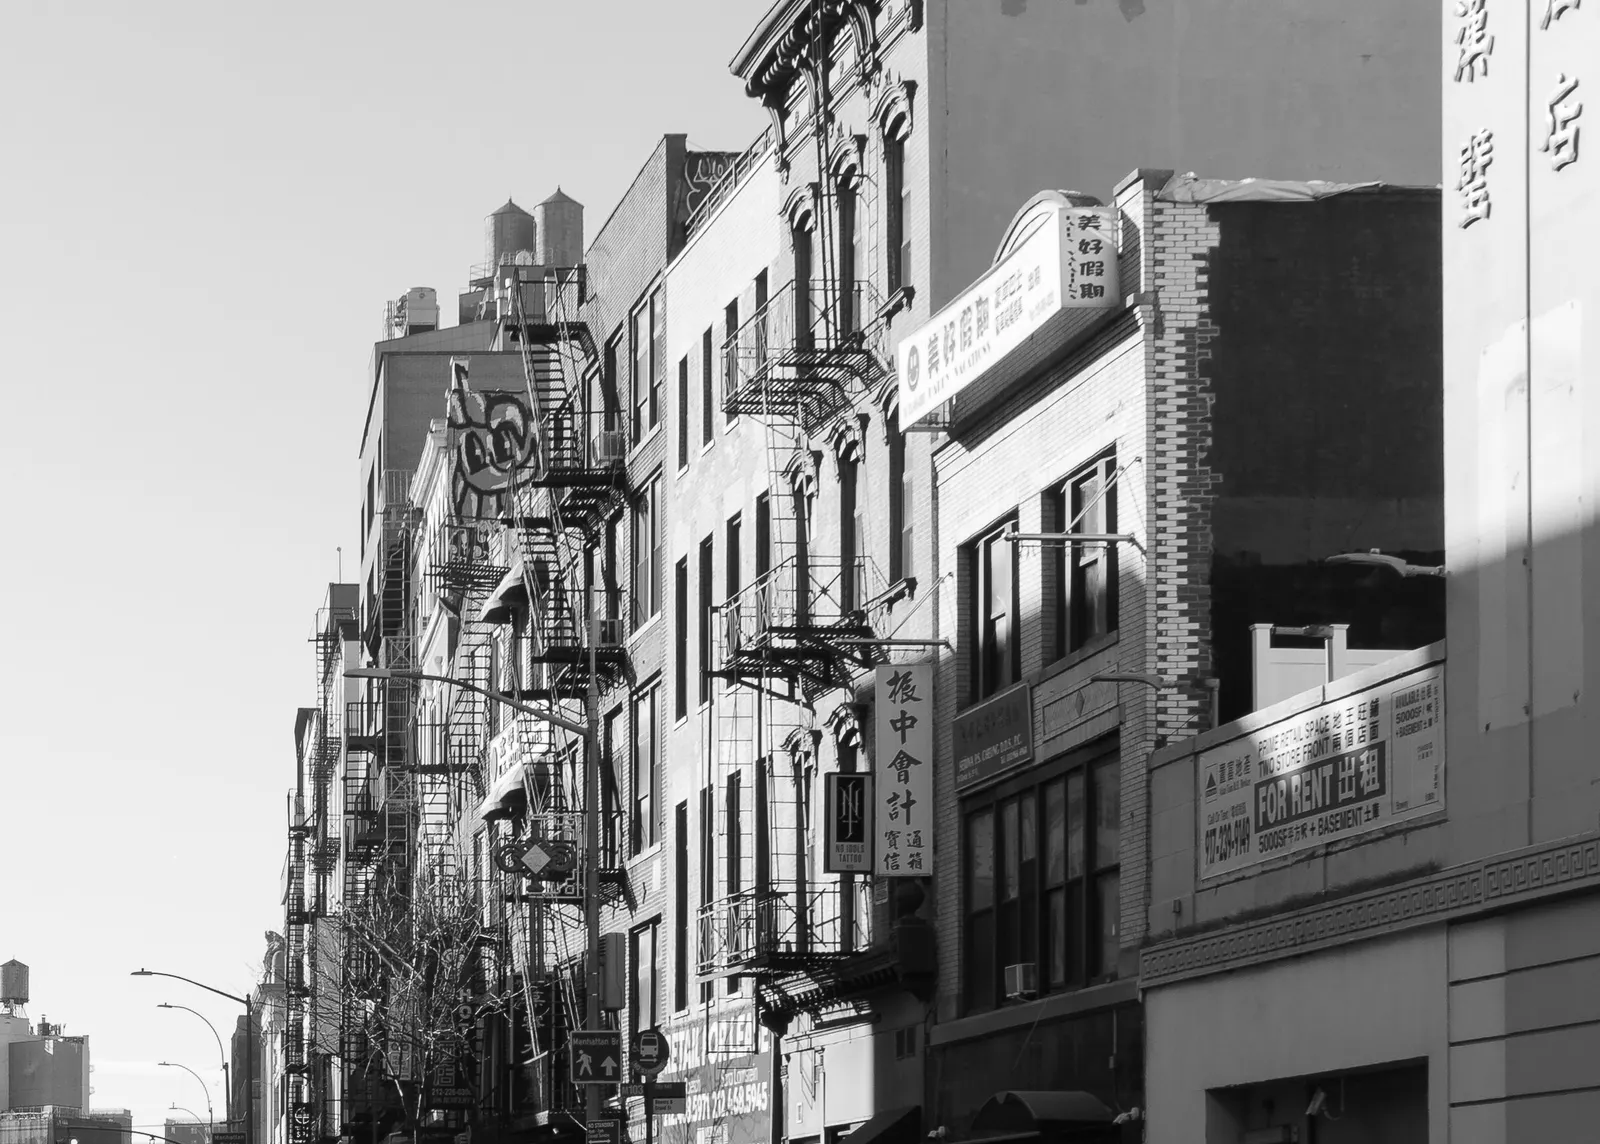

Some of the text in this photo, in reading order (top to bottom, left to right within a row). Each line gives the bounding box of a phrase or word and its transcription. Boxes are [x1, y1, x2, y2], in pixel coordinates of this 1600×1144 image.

[1078, 215, 1104, 299] 美好假期
[928, 296, 989, 379] 美好假期
[1258, 736, 1279, 758] PRIME
[1280, 728, 1304, 749] RETAIL
[1305, 715, 1330, 741] SPACE
[1258, 760, 1275, 778] TWO
[1276, 748, 1300, 772] STORE
[1303, 736, 1330, 762] FRONT
[1257, 749, 1380, 827] FOR RENT 出租
[1205, 816, 1250, 865] 917-239-9149
[1317, 806, 1363, 836] BASEMENT
[836, 844, 847, 853] NO
[839, 854, 862, 863] TATTOO
[573, 1037, 620, 1046] Manhattan Br
[621, 1084, 644, 1095] M103
